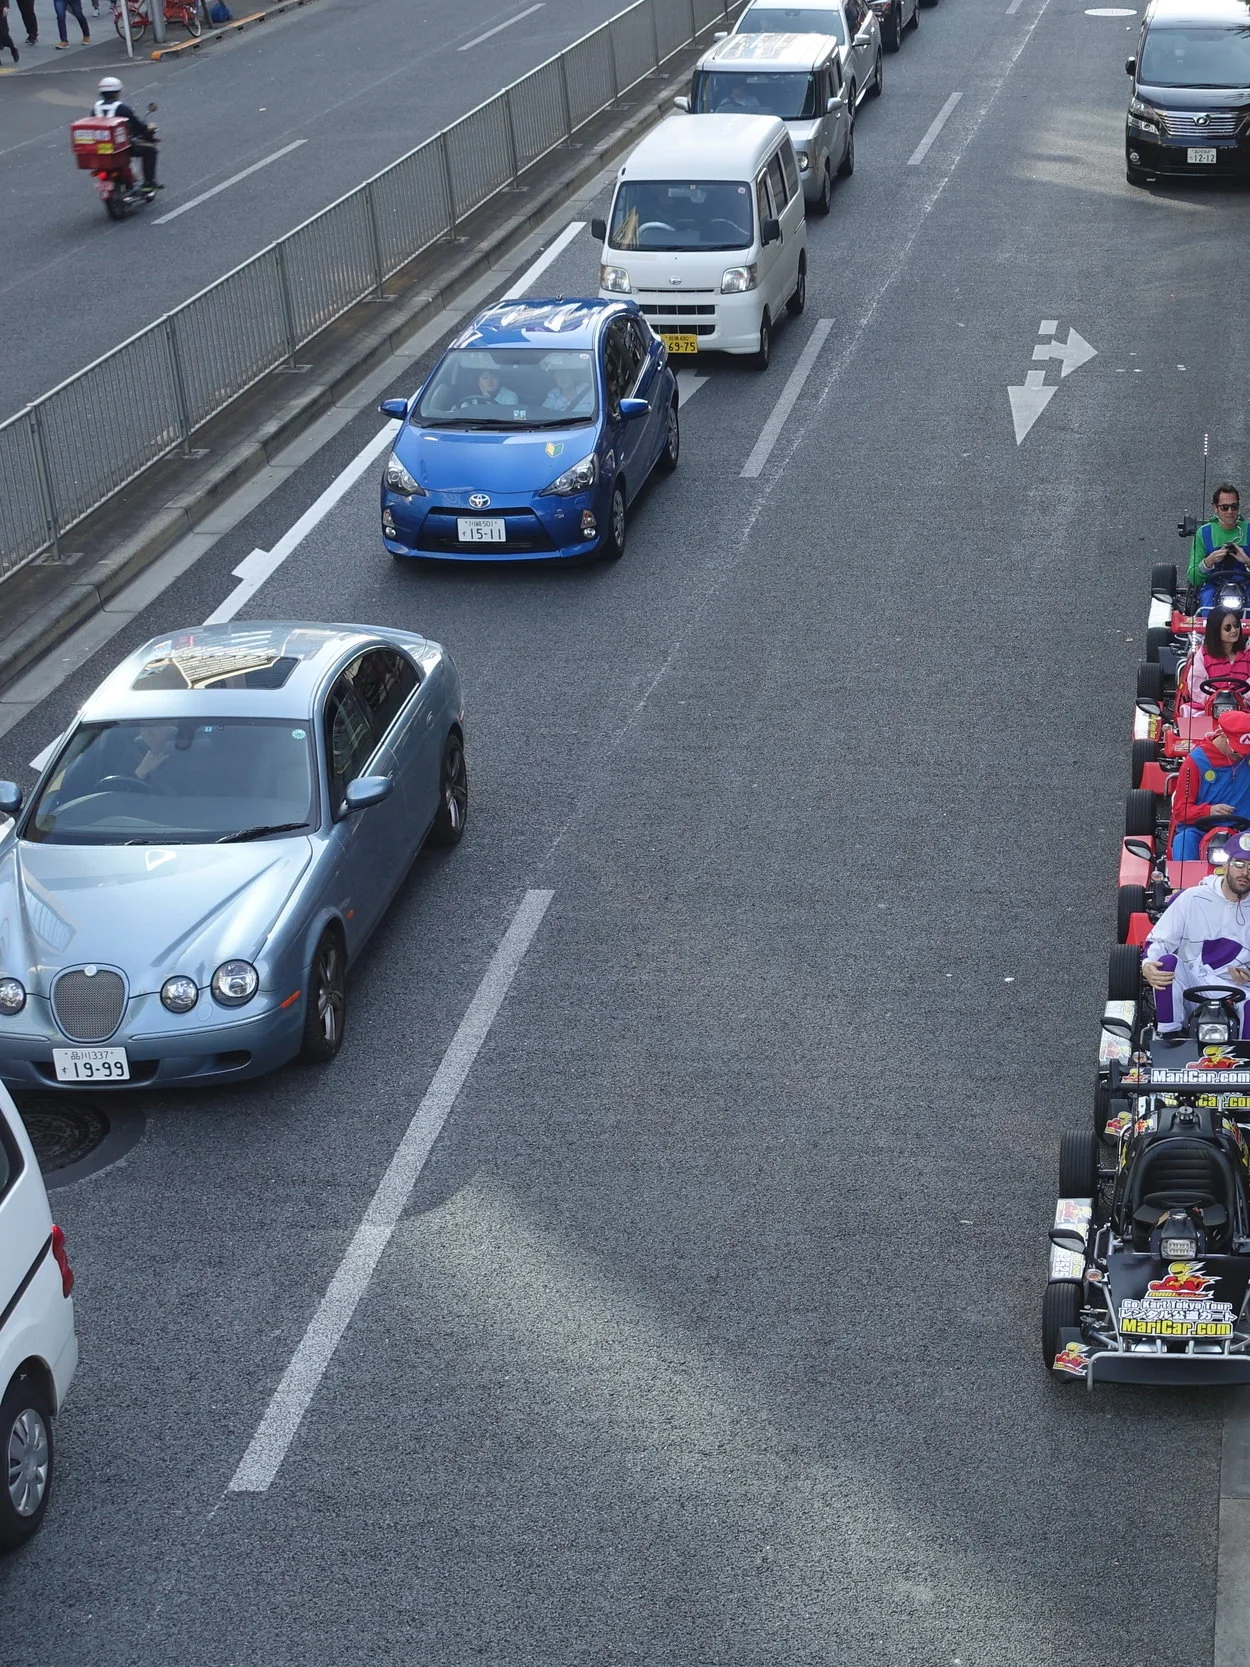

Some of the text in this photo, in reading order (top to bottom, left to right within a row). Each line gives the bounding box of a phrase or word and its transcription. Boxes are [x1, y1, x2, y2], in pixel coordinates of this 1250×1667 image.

[1195, 155, 1215, 163] 12-12
[668, 341, 696, 352] 69-75
[470, 528, 502, 540] 15-11
[71, 1051, 109, 1060] 品川337
[74, 1061, 125, 1078] 19-99
[1123, 1299, 1231, 1310] Go Kart Tokyo Tour
[1120, 1308, 1238, 1321] レンタル公道カート
[1122, 1319, 1232, 1335] MariCar.com
